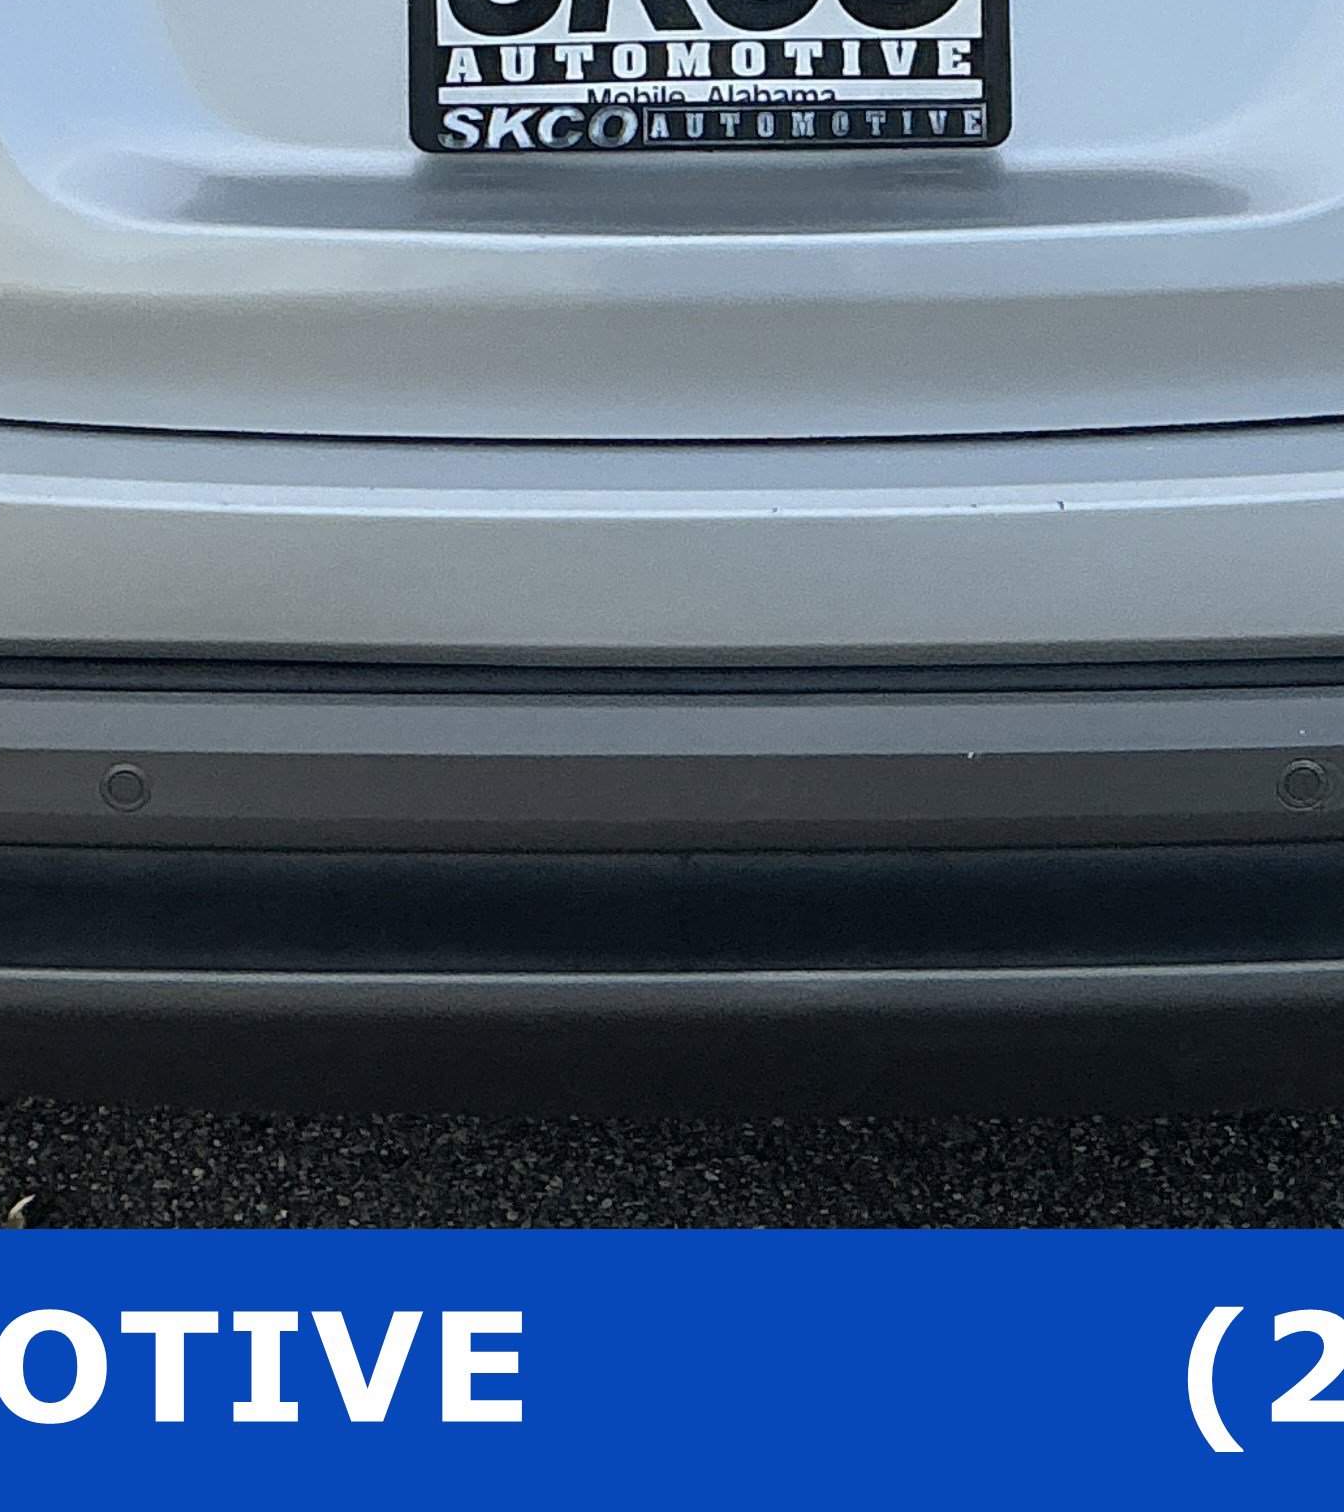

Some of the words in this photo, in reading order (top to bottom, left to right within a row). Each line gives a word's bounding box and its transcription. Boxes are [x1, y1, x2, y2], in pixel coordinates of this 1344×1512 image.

[445, 40, 972, 83] AUTOMOTIVE
[437, 106, 639, 149] SKCO
[649, 110, 983, 139] AUTOMOTIVE
